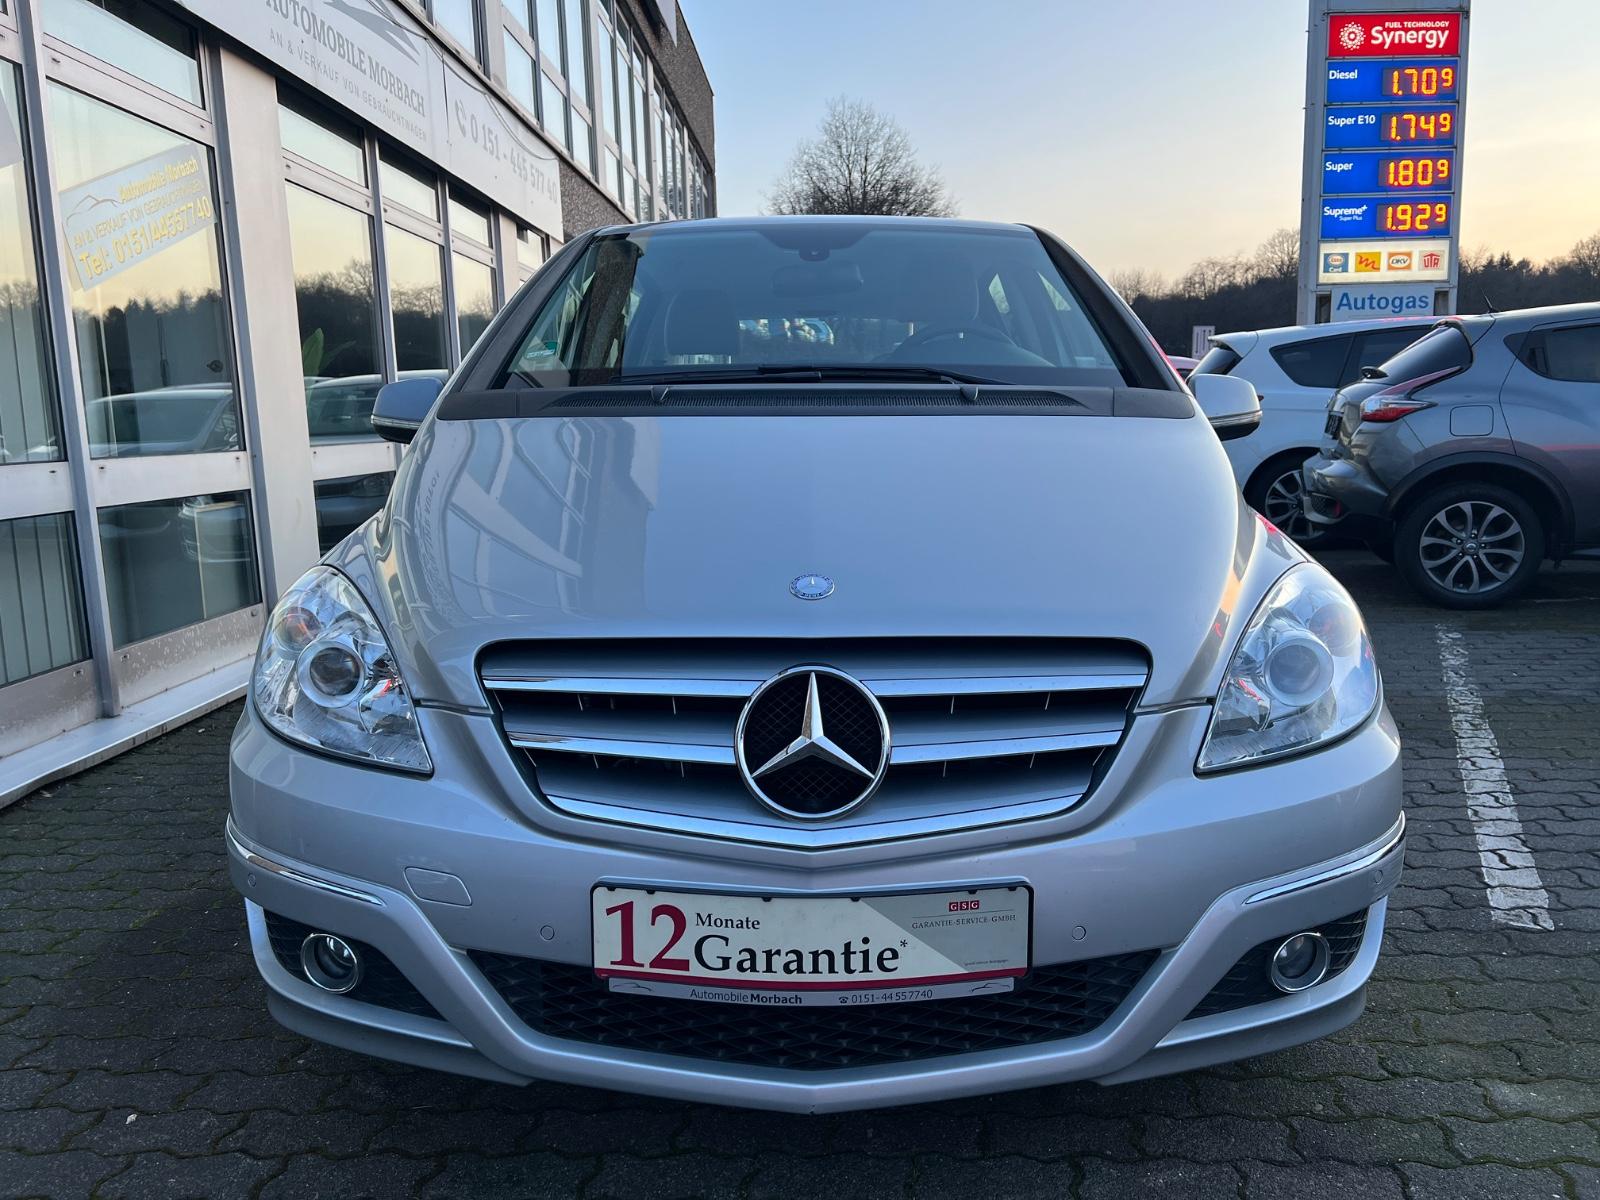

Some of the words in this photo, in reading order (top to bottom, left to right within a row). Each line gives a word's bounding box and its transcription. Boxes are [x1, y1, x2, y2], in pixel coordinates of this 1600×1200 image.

[1385, 21, 1403, 29] FUEL
[1370, 26, 1449, 49] Synergy
[269, 28, 283, 48] AN
[287, 40, 294, 56] &
[298, 45, 339, 82] VERKAUF
[343, 77, 360, 98] VON
[362, 90, 427, 141] GEBRAUCHTWAGEN
[1328, 69, 1358, 80] Diesel
[368, 55, 426, 117] MORBACH
[1327, 116, 1356, 127] Super
[1357, 115, 1376, 125] E10
[470, 113, 479, 144] 0
[482, 124, 501, 161] 151
[510, 148, 528, 182] 445
[530, 164, 545, 194] 577
[1325, 161, 1354, 173] Super
[119, 172, 166, 204] Automobile
[164, 156, 199, 182] Morbach
[1424, 253, 1441, 268] UTA
[1336, 292, 1430, 314] Autogas
[949, 900, 979, 912] GSG
[695, 912, 761, 930] Monate
[605, 901, 690, 972] 12
